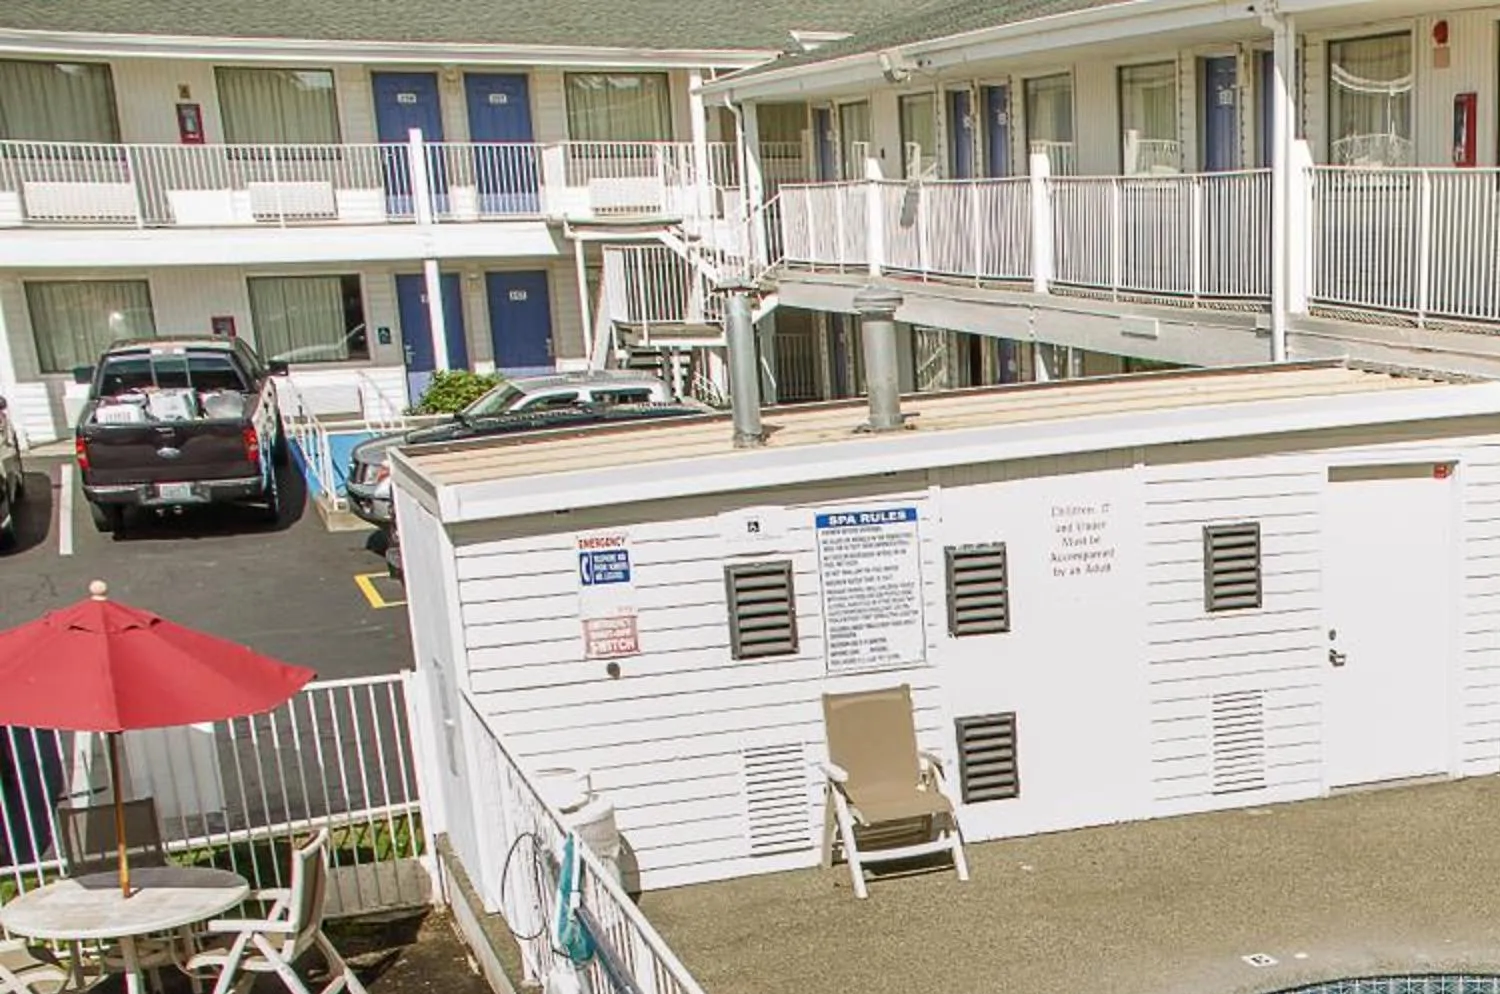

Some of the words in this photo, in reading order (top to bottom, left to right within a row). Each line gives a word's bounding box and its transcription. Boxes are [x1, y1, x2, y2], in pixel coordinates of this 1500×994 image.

[828, 514, 857, 526] SPA
[859, 510, 907, 524] RULES
[578, 536, 625, 549] EMERGENCY
